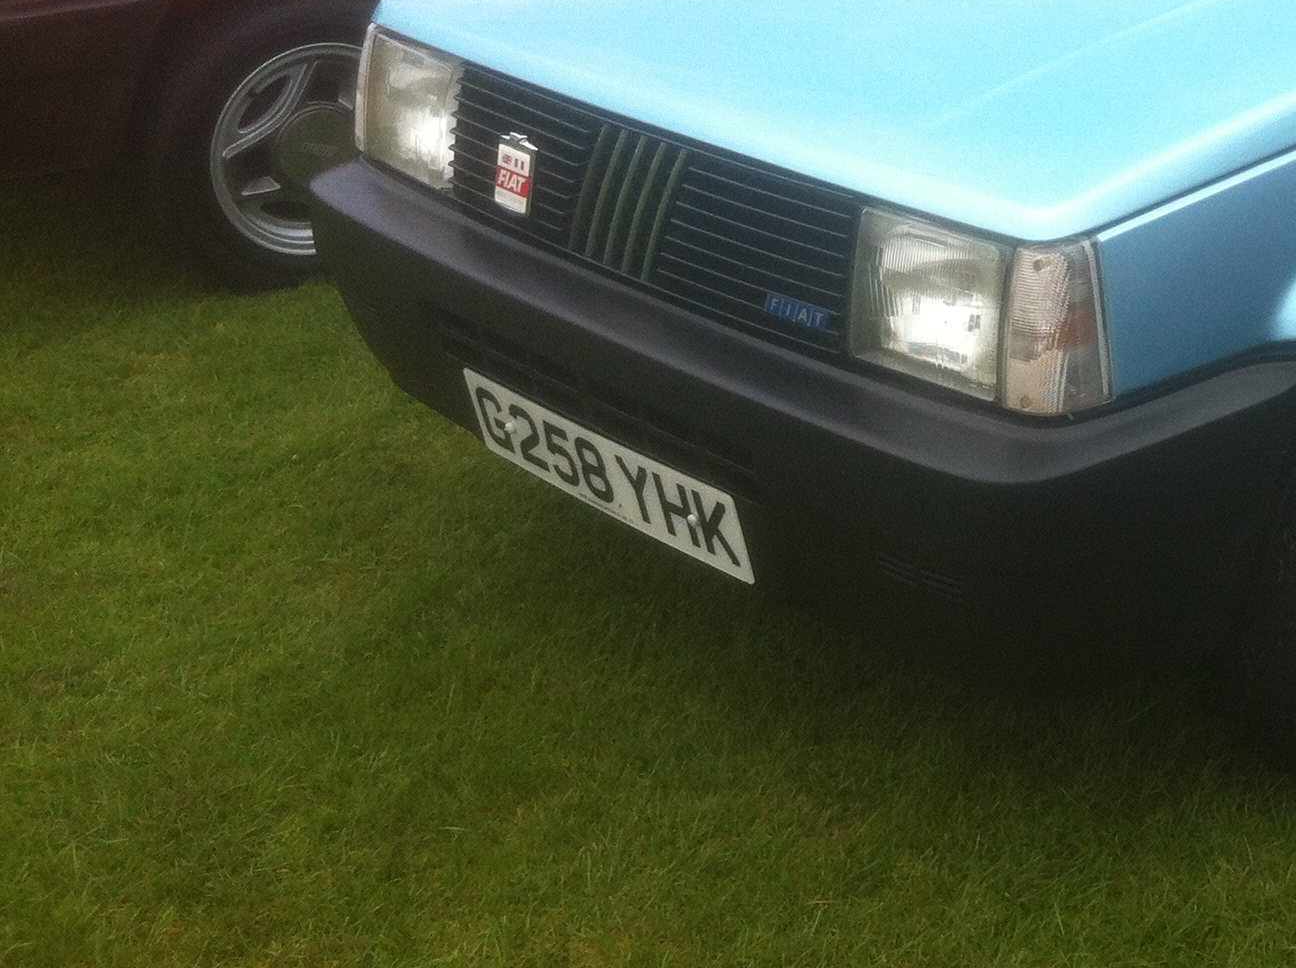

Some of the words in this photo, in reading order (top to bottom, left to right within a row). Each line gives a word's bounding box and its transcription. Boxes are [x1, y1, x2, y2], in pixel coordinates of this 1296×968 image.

[496, 168, 527, 193] FIAT
[770, 298, 824, 327] FIAT
[475, 386, 615, 504] G258
[613, 453, 741, 569] YHK
